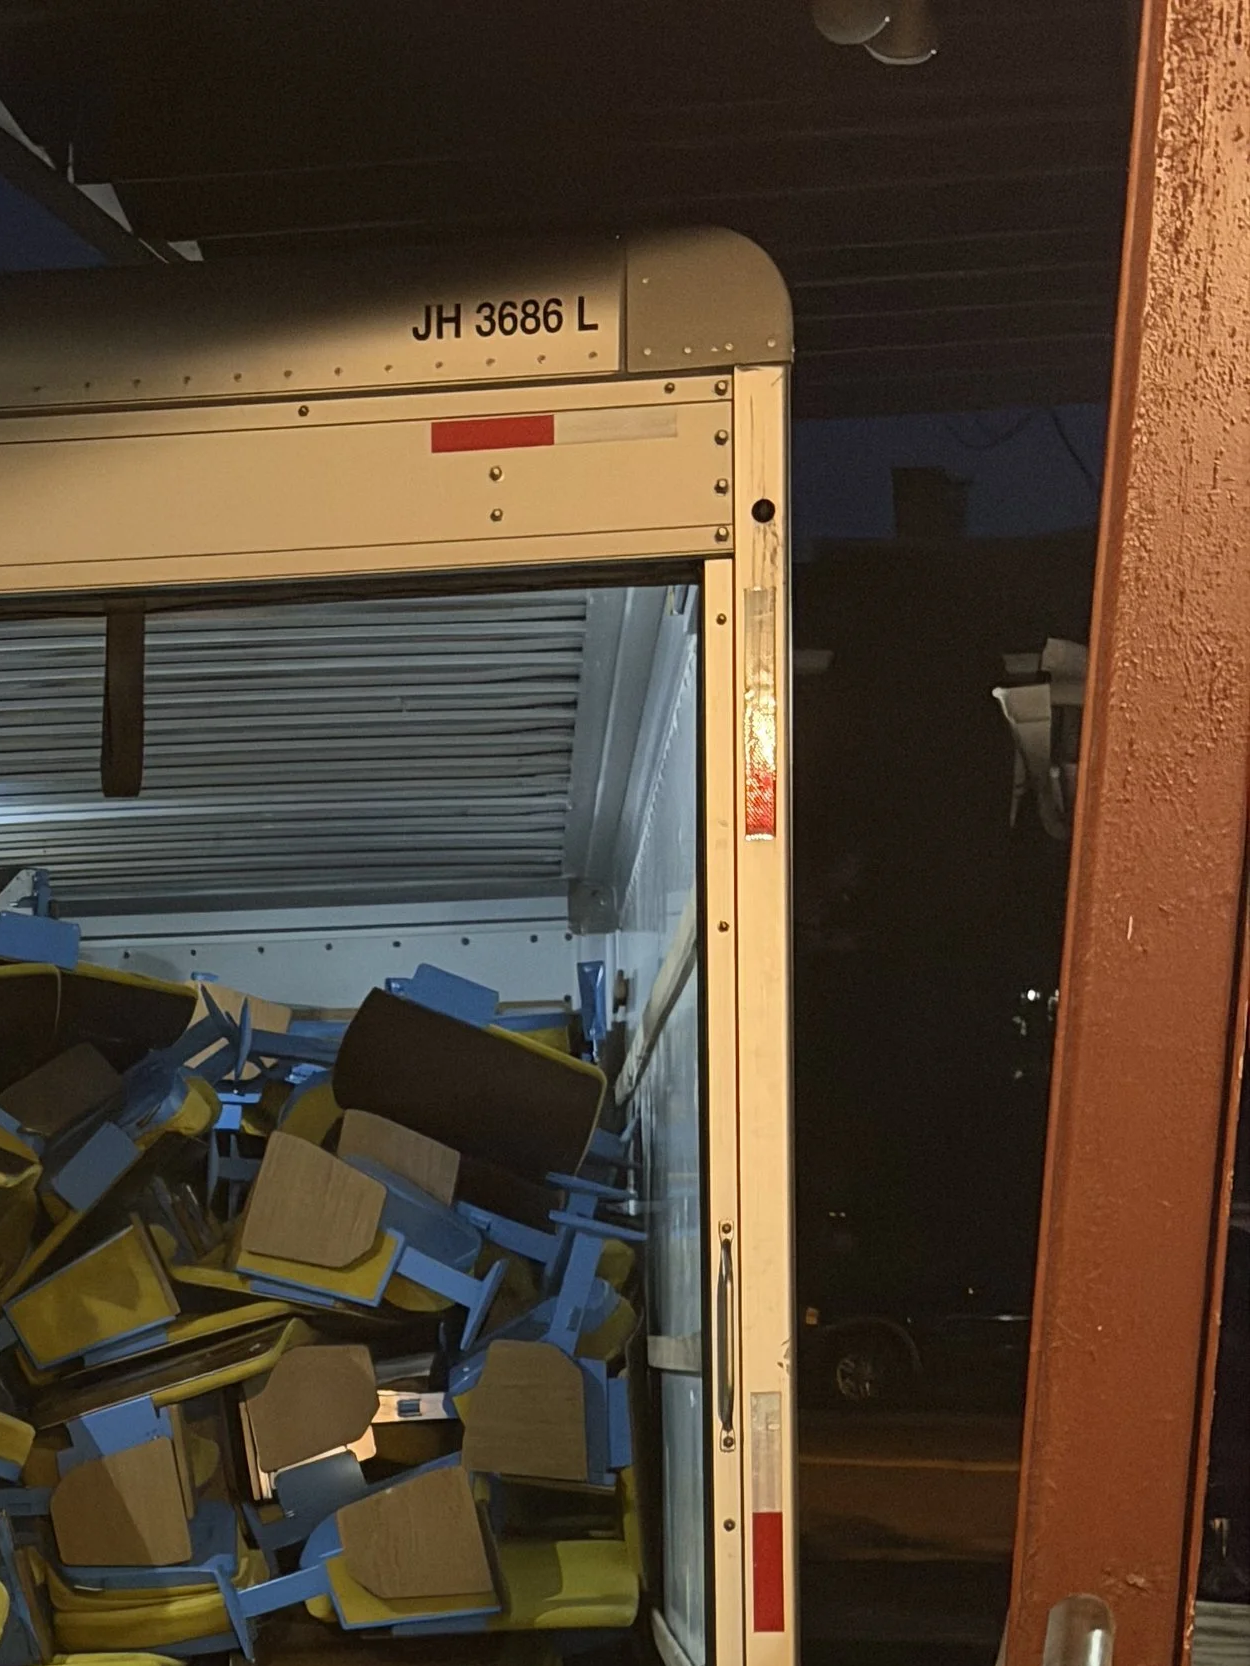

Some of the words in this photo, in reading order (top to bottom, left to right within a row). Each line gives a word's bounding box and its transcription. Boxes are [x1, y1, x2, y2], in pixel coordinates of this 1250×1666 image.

[412, 302, 461, 341] JH
[475, 298, 564, 338] 3686
[577, 295, 599, 331] L
